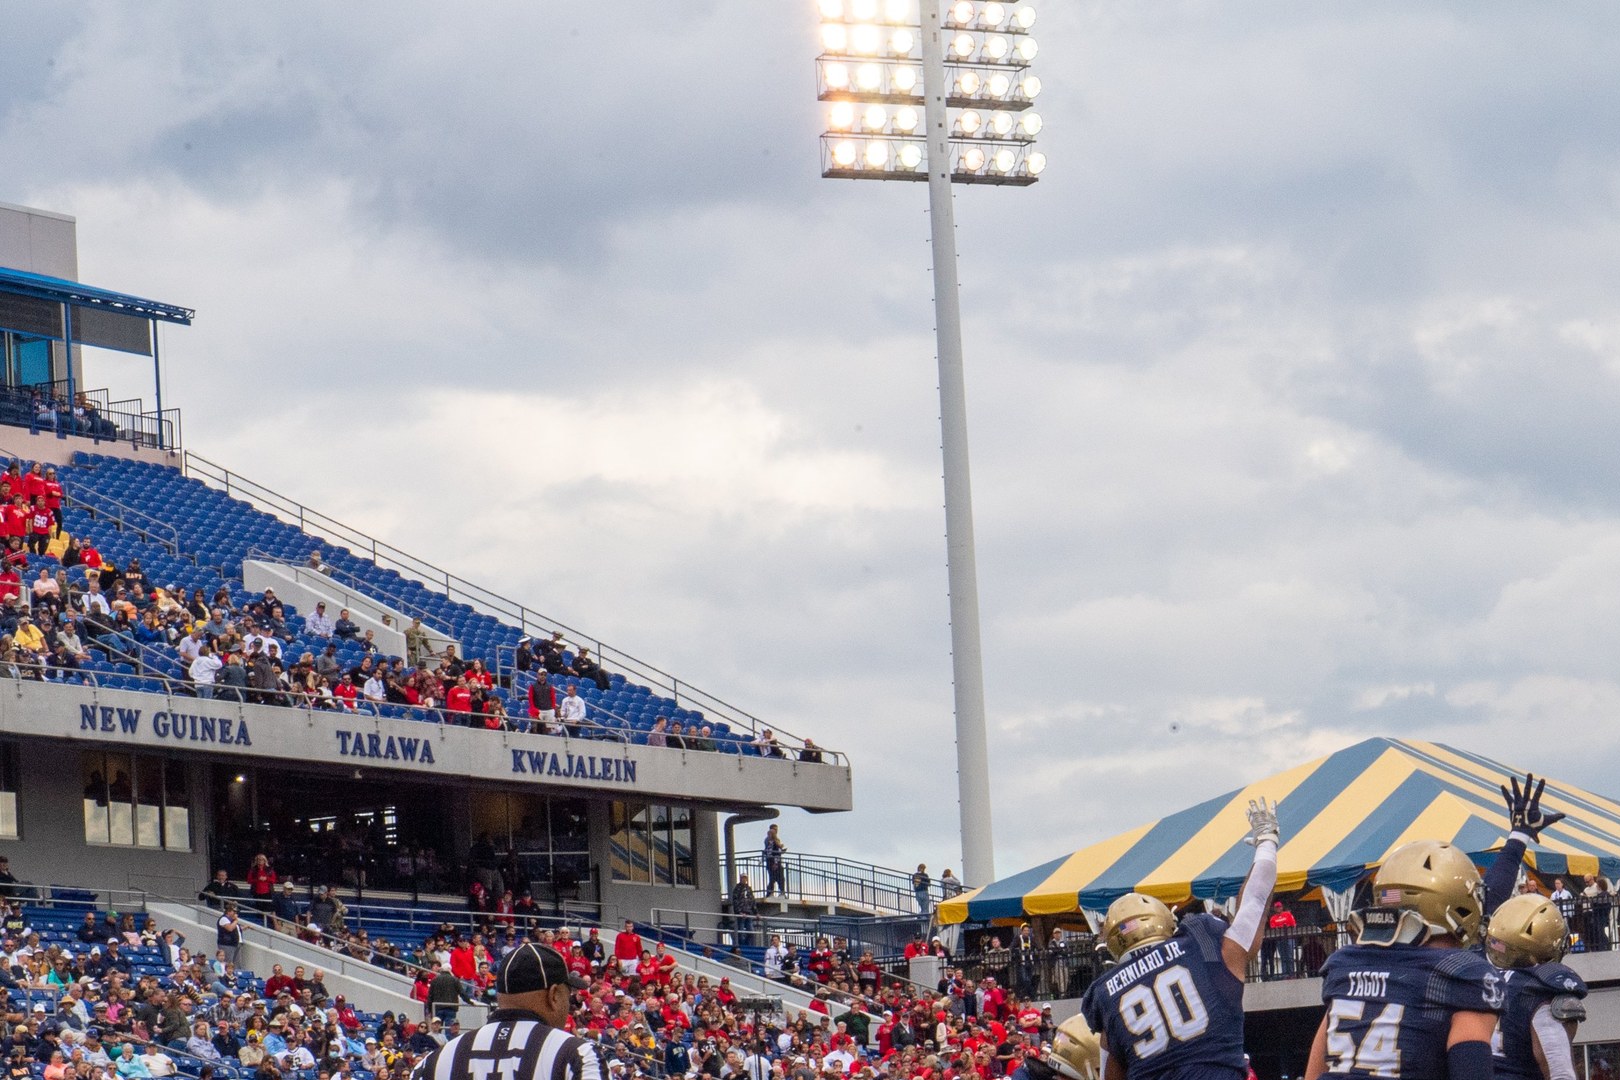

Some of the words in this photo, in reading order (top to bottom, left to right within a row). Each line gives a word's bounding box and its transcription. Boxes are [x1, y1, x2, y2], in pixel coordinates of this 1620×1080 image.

[79, 704, 141, 734] NEW
[153, 711, 252, 746] GUINEA
[336, 730, 435, 764] TARAWA
[511, 749, 637, 782] KWAJALEIN
[1105, 950, 1164, 996] BERNIARD
[1164, 941, 1186, 962] JR.
[1347, 971, 1390, 997] FAGOT
[1119, 964, 1210, 1059] 90
[1327, 999, 1405, 1078] 54
